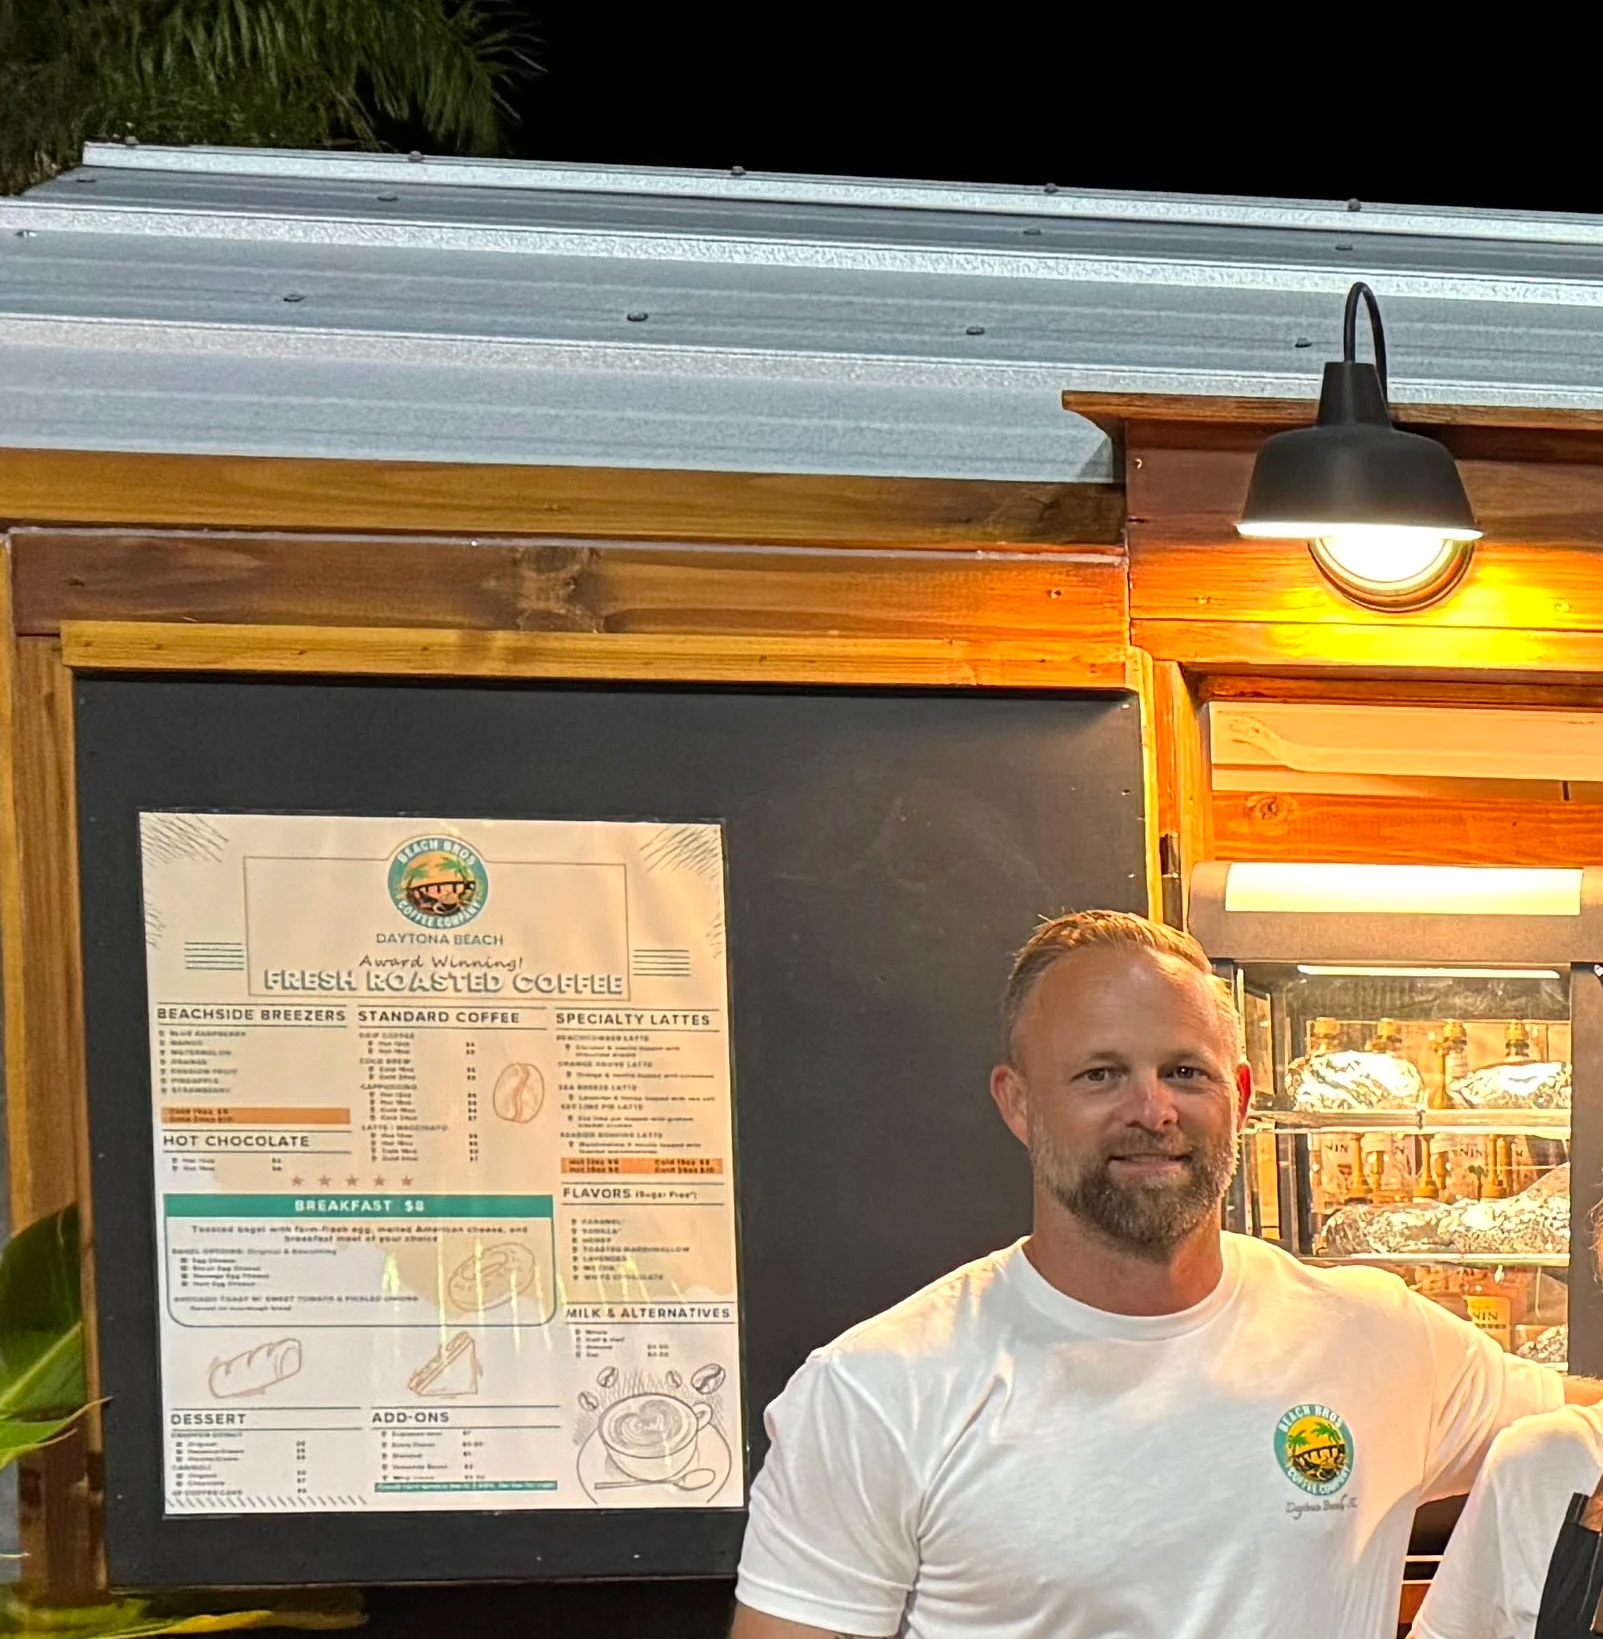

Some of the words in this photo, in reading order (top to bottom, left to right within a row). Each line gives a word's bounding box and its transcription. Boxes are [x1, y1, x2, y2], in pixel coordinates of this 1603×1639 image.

[396, 839, 439, 864] BEACH
[443, 841, 476, 866] BROS
[376, 933, 450, 944] DAYTONA
[454, 934, 504, 945] BEACH
[359, 954, 423, 968] Award
[263, 969, 357, 992] FRESH
[366, 970, 505, 993] ROASTED
[513, 973, 624, 995] COFFEE
[157, 1008, 254, 1019] BEACHSIDE
[260, 1009, 346, 1022] BREEZERS
[358, 1011, 449, 1022] STANDARD
[456, 1012, 520, 1023] COFFEE
[556, 1013, 644, 1025] SPECIALTY
[650, 1014, 711, 1026] LATTES
[163, 1135, 199, 1146] HOT
[205, 1135, 310, 1147] CHOCOLATE
[563, 1188, 631, 1199] FLAVORS
[636, 1190, 666, 1200] (Sugar
[294, 1200, 392, 1212] BREAKFAST
[404, 1201, 425, 1212] $8
[566, 1308, 601, 1318] MILK
[607, 1309, 616, 1318] &
[621, 1308, 730, 1318] ALTERNATIVES
[171, 1414, 246, 1425] DESSERT
[372, 1412, 449, 1423] ADD-ONS
[1278, 1406, 1311, 1432] BEACH
[1315, 1405, 1343, 1427] BROS
